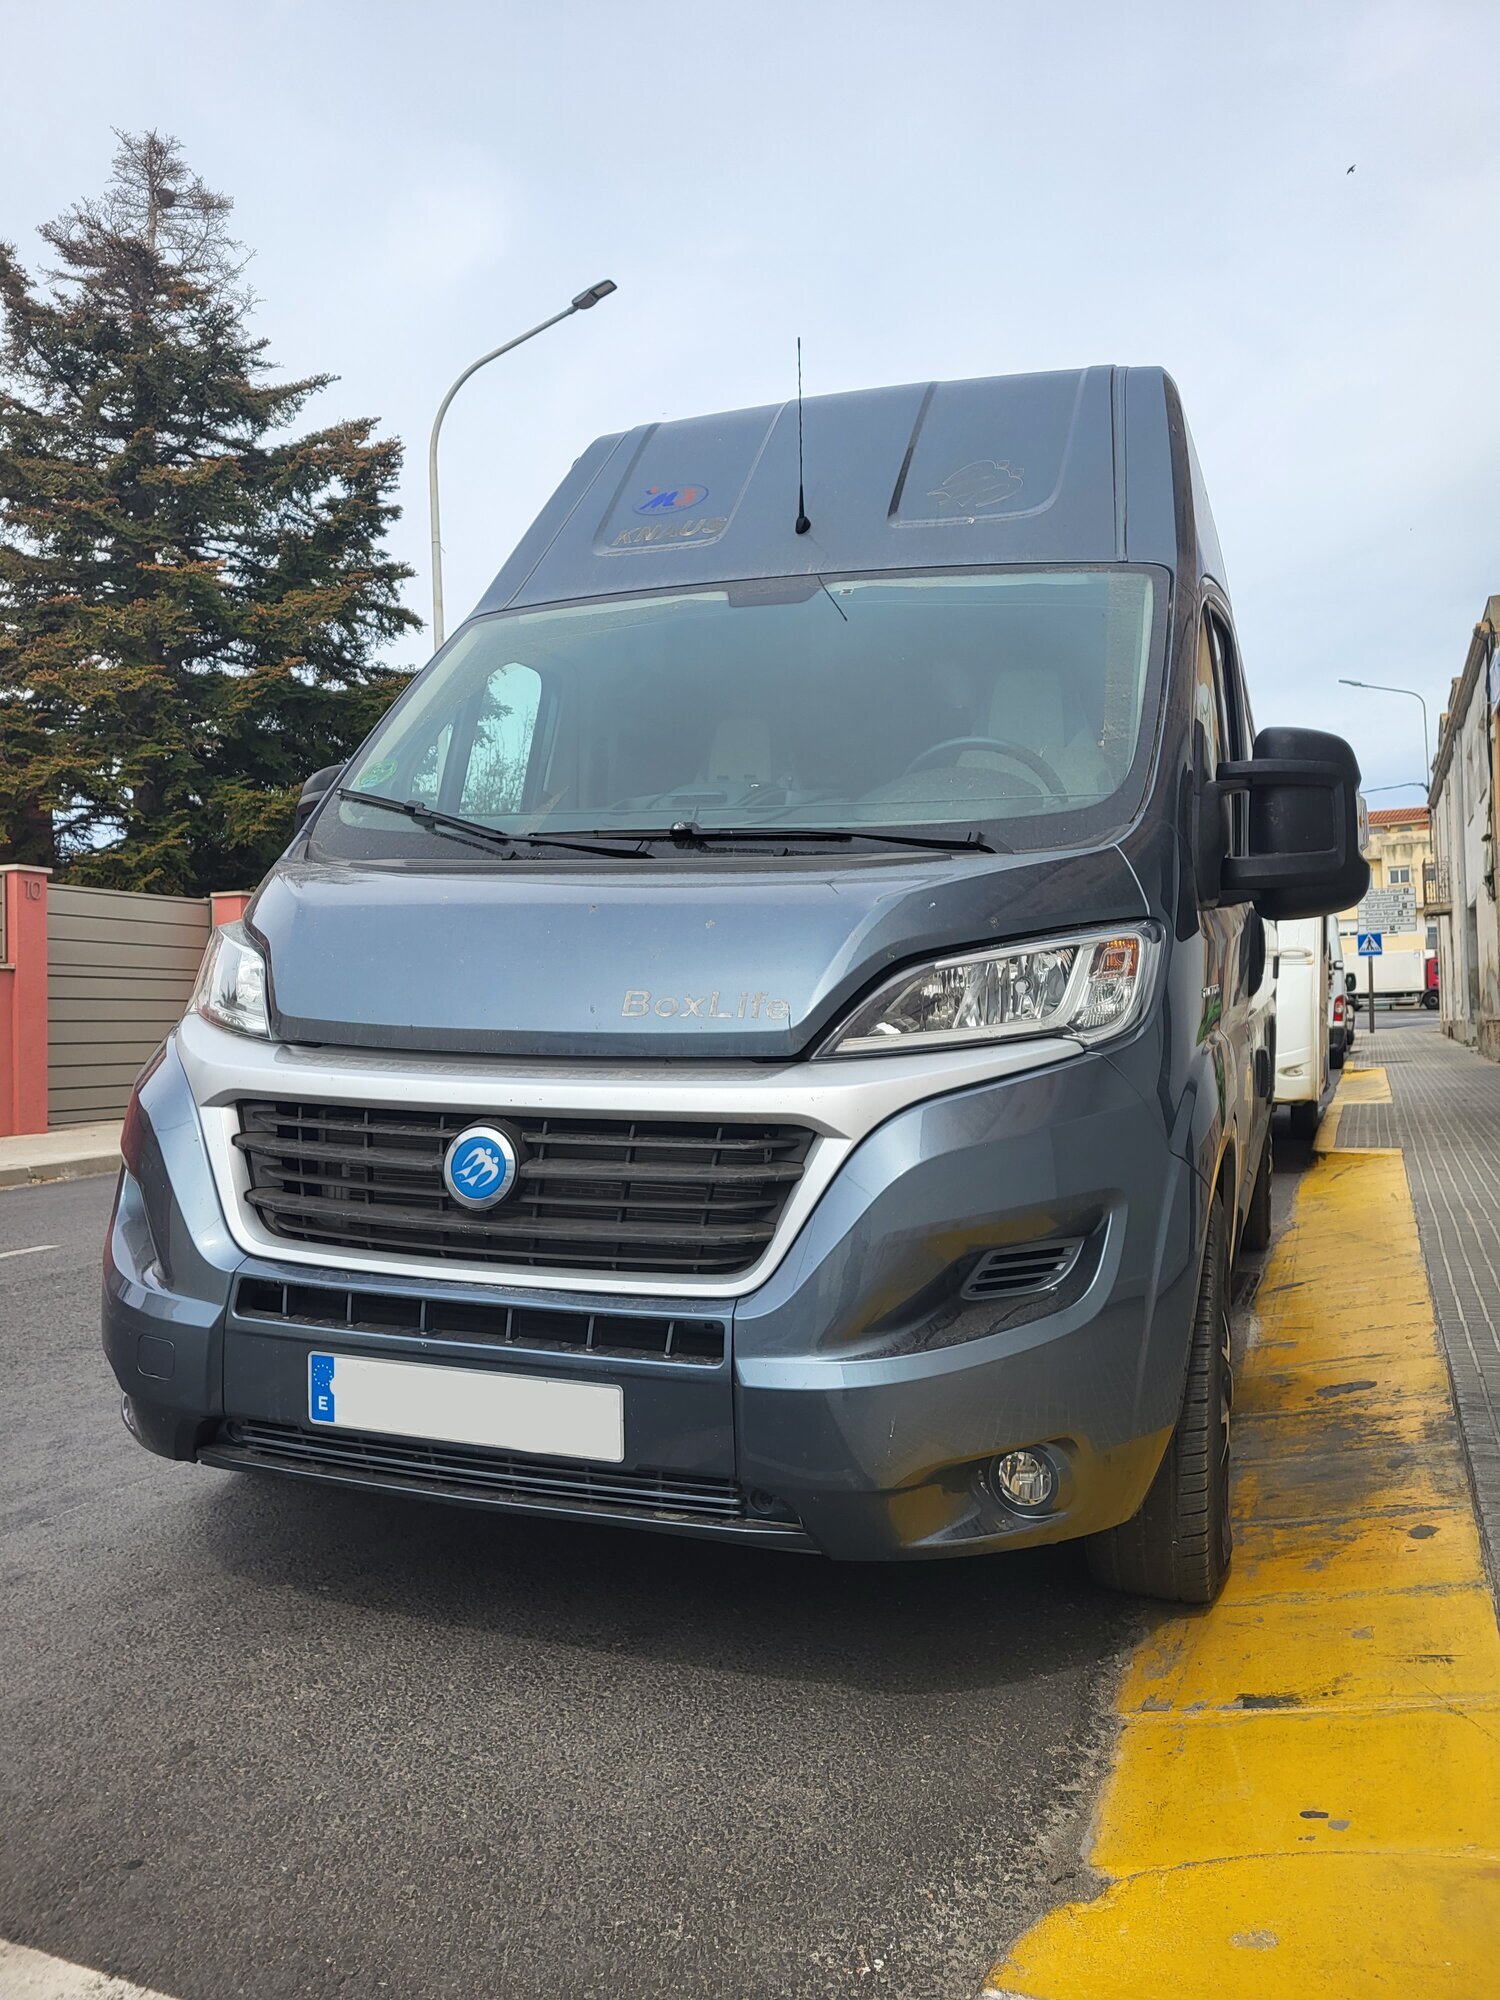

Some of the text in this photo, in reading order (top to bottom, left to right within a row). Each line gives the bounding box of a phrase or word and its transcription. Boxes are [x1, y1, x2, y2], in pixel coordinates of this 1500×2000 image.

[612, 517, 727, 546] KNAUS
[24, 880, 41, 900] 10
[621, 989, 791, 1020] BoxLife
[318, 1396, 329, 1411] E
